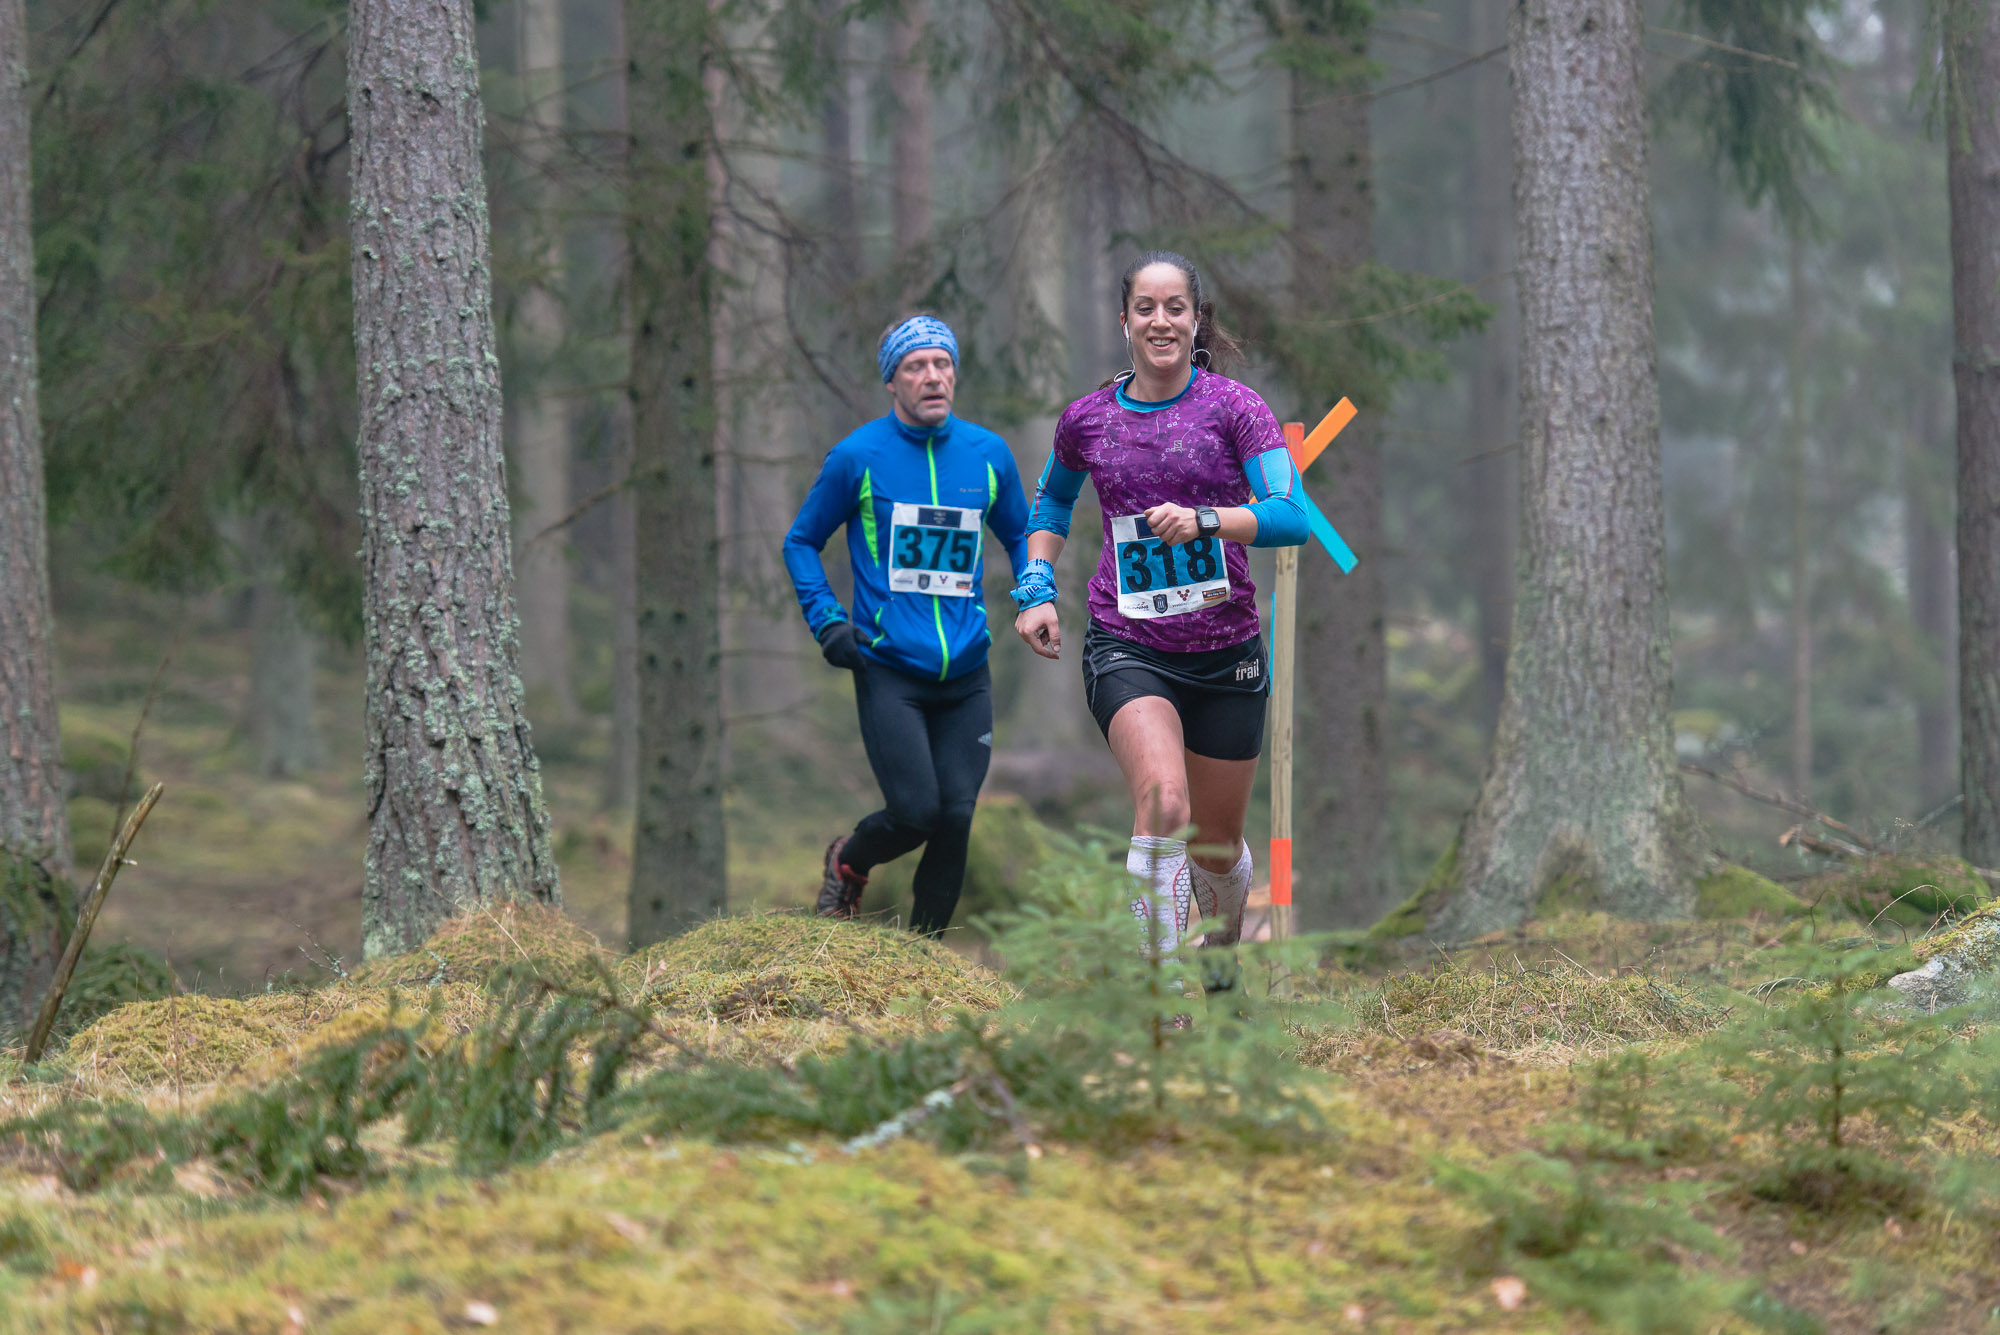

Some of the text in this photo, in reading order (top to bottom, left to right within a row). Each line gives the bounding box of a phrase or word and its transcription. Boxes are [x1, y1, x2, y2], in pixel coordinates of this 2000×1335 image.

[898, 527, 973, 572] 375
[1123, 536, 1216, 592] 318
[1235, 658, 1260, 681] trail
